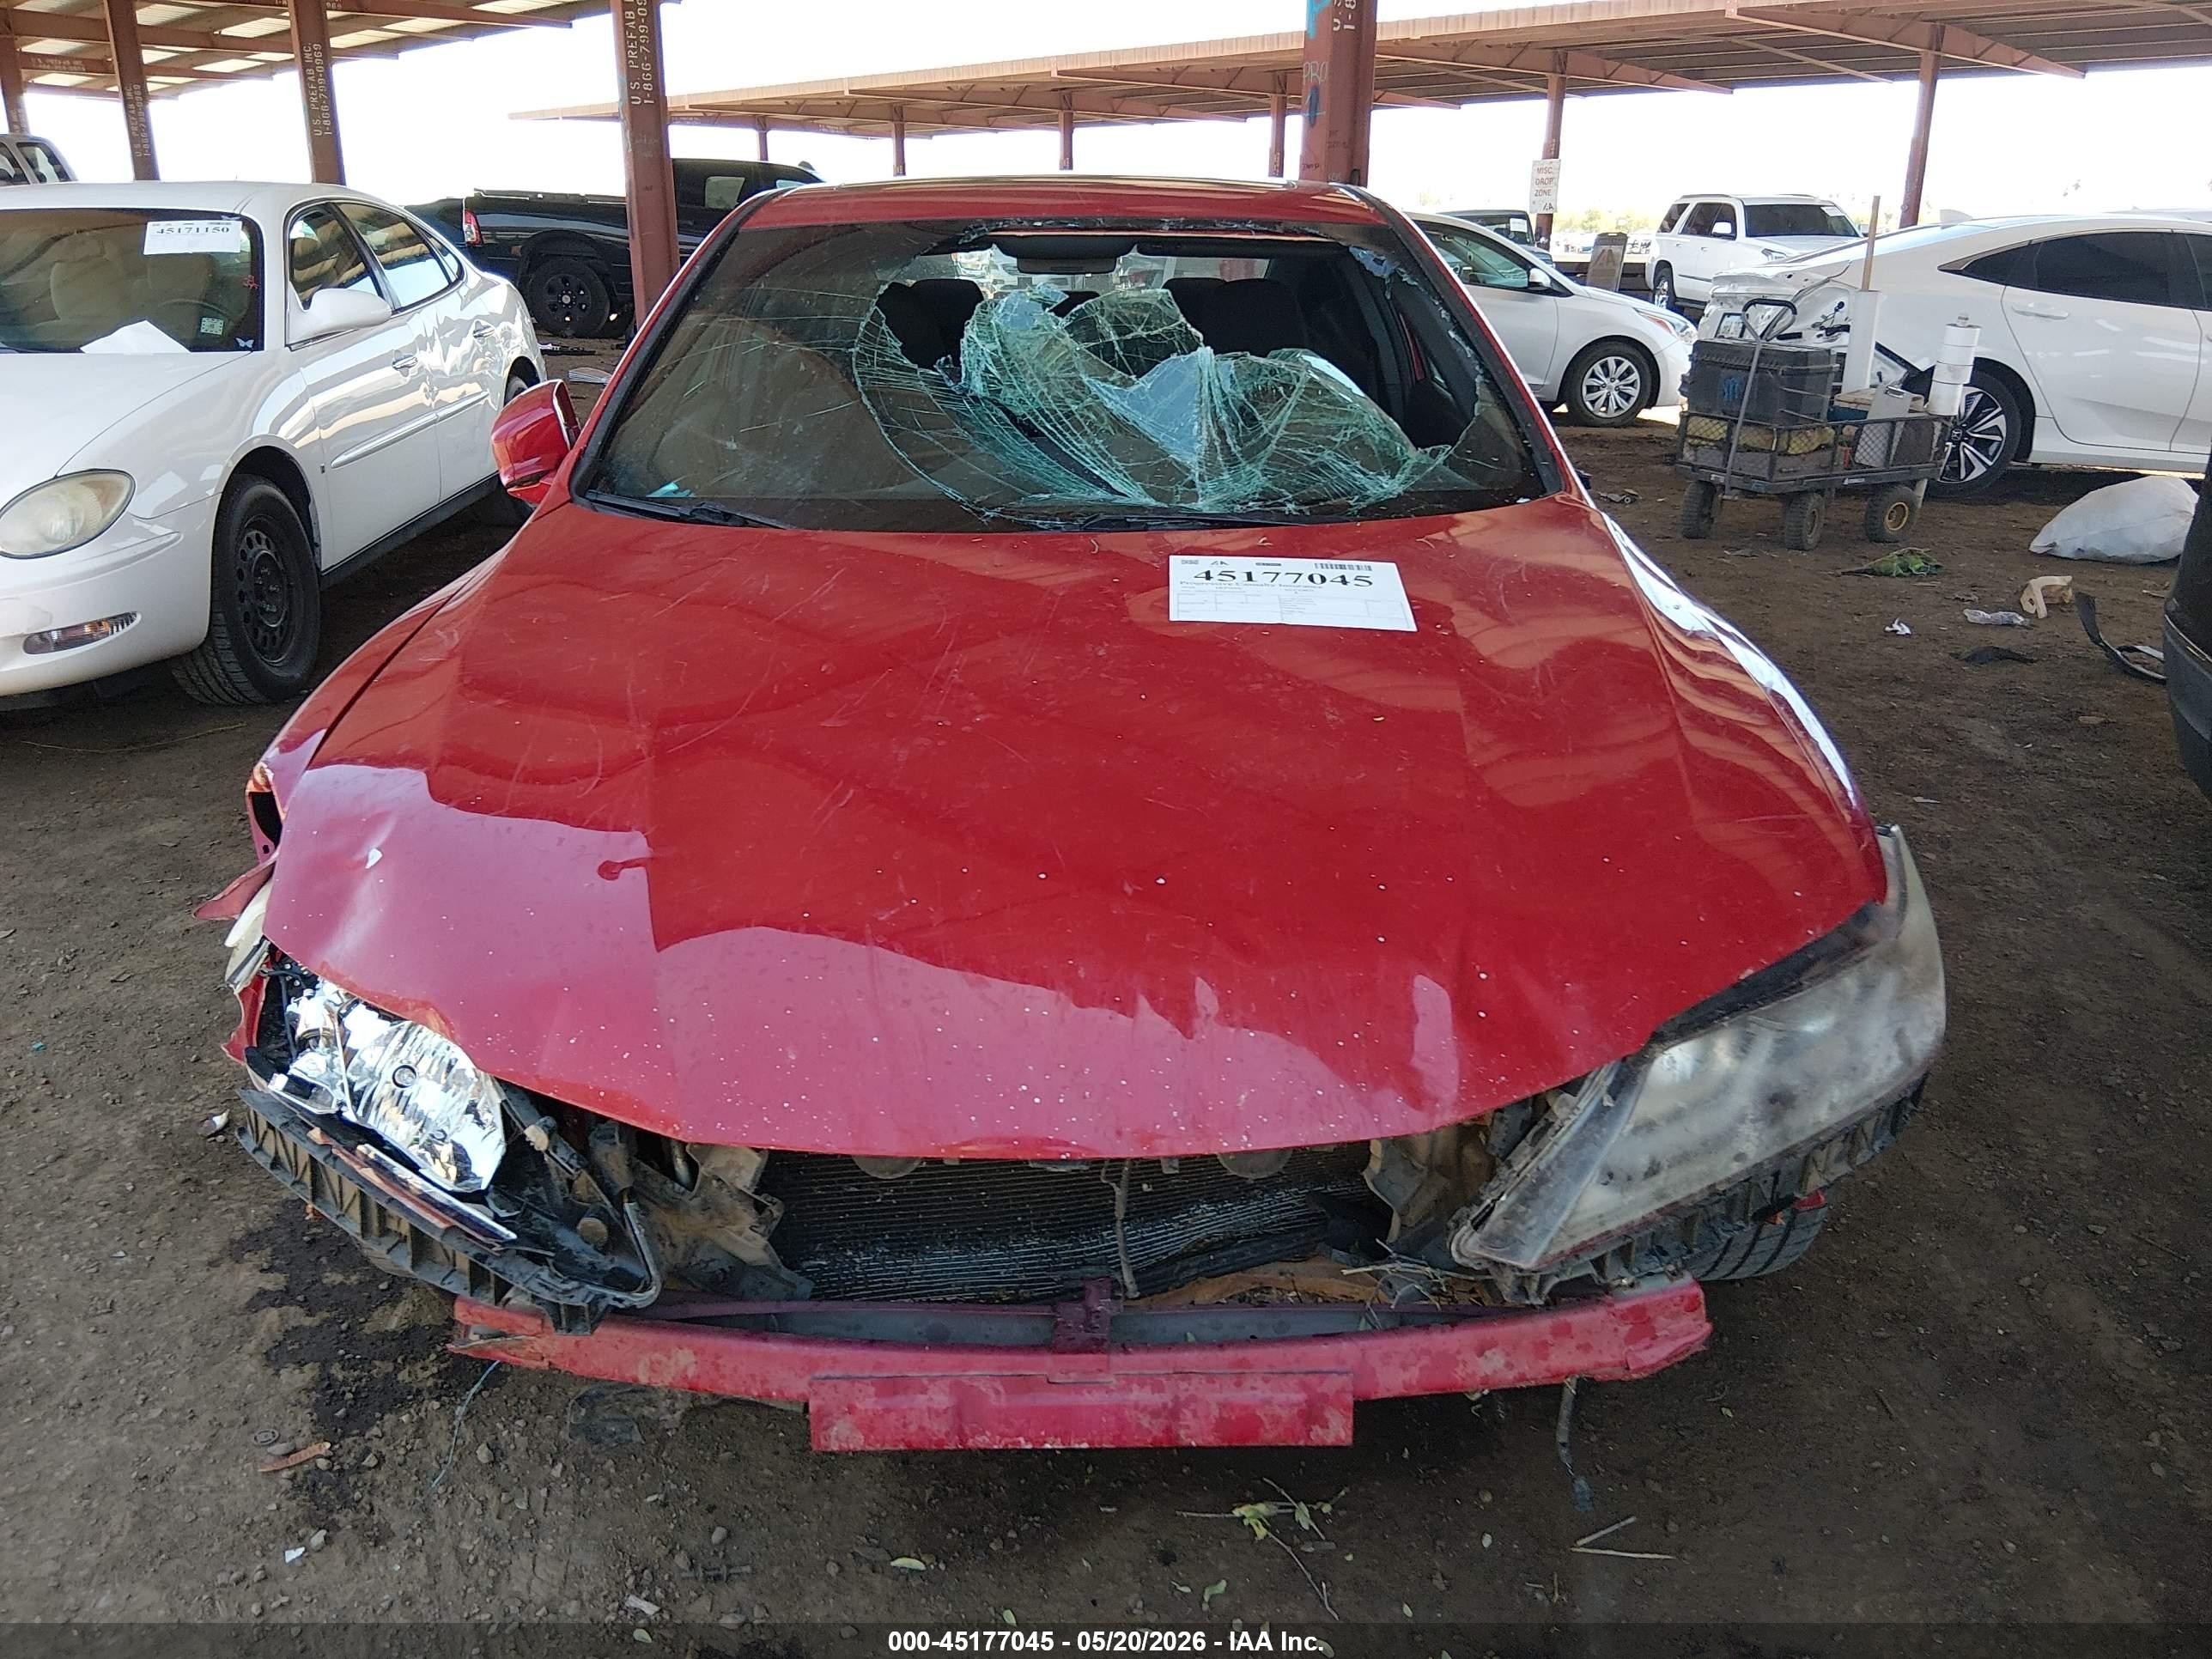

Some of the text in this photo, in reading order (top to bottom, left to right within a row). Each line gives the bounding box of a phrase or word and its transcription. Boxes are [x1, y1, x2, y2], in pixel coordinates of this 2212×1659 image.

[625, 10, 639, 69] PREFAB
[306, 68, 320, 110] PREFAB
[1194, 569, 1373, 587] 45177045
